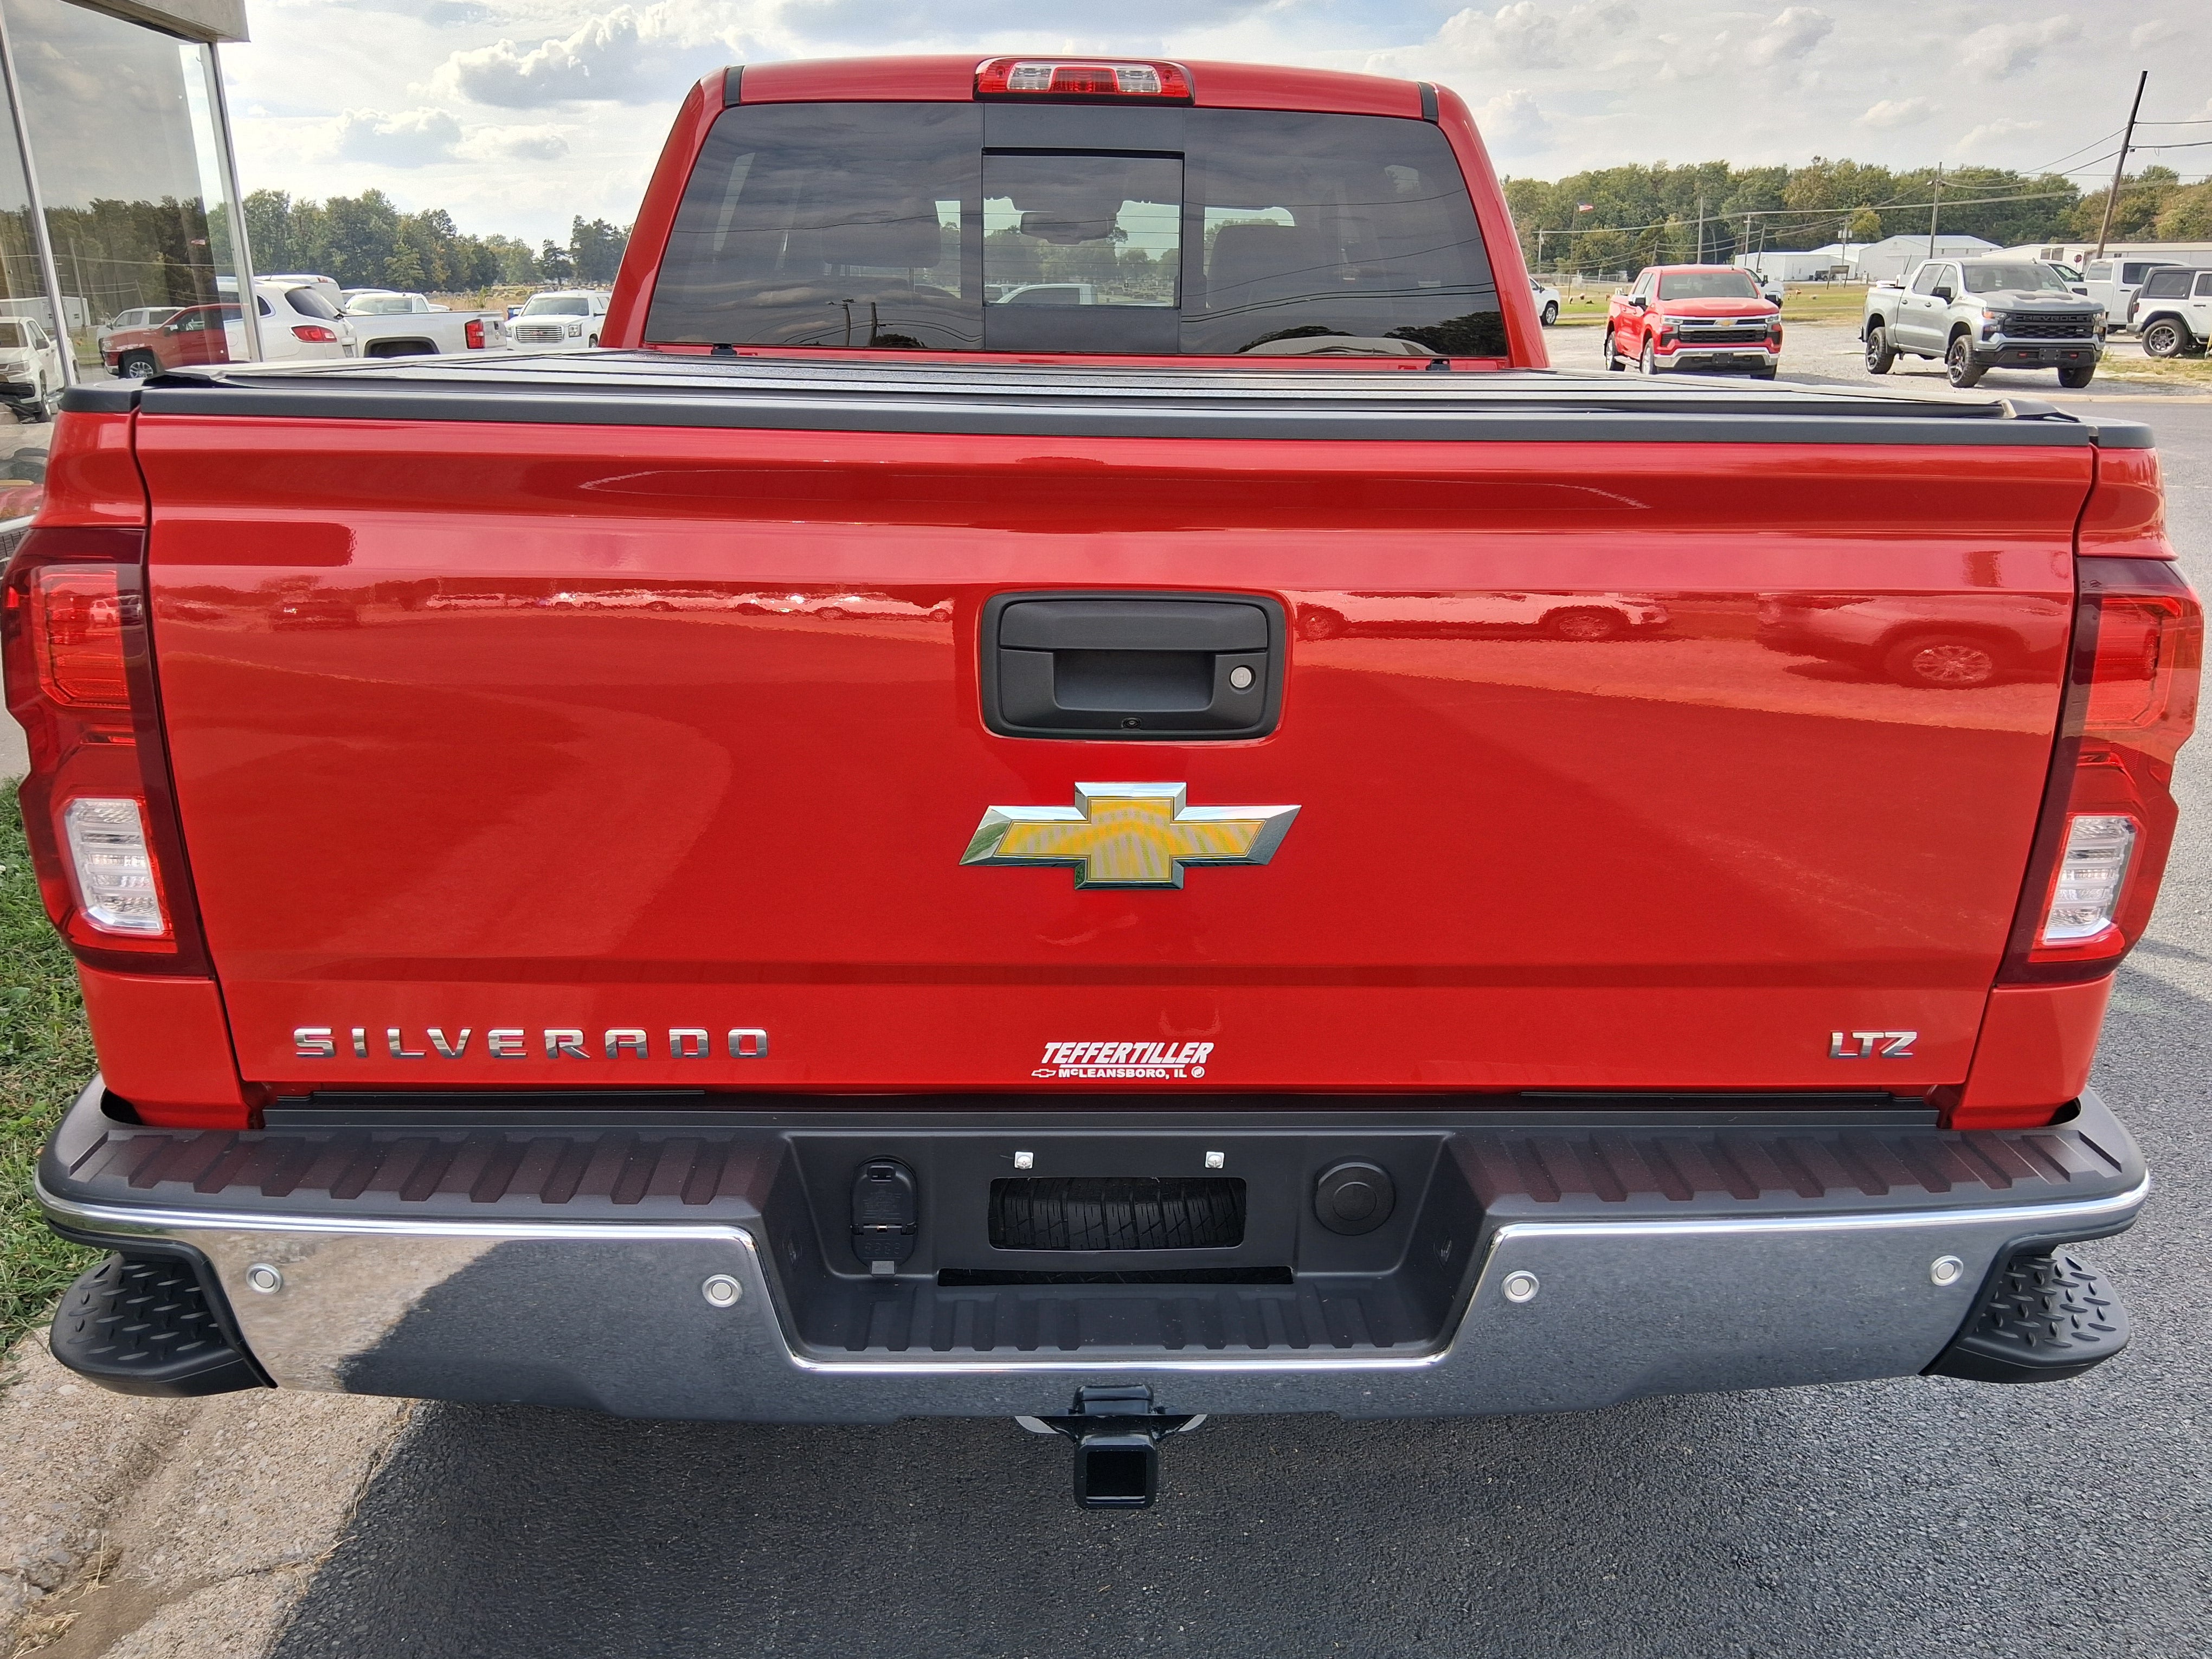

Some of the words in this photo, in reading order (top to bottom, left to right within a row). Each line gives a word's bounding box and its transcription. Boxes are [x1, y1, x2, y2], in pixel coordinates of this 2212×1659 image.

[293, 1027, 769, 1059] SILVERADO
[1041, 1041, 1214, 1063] TEFFERTILLER
[1828, 1031, 1918, 1058] LTZ
[1174, 1069, 1188, 1078] IL
